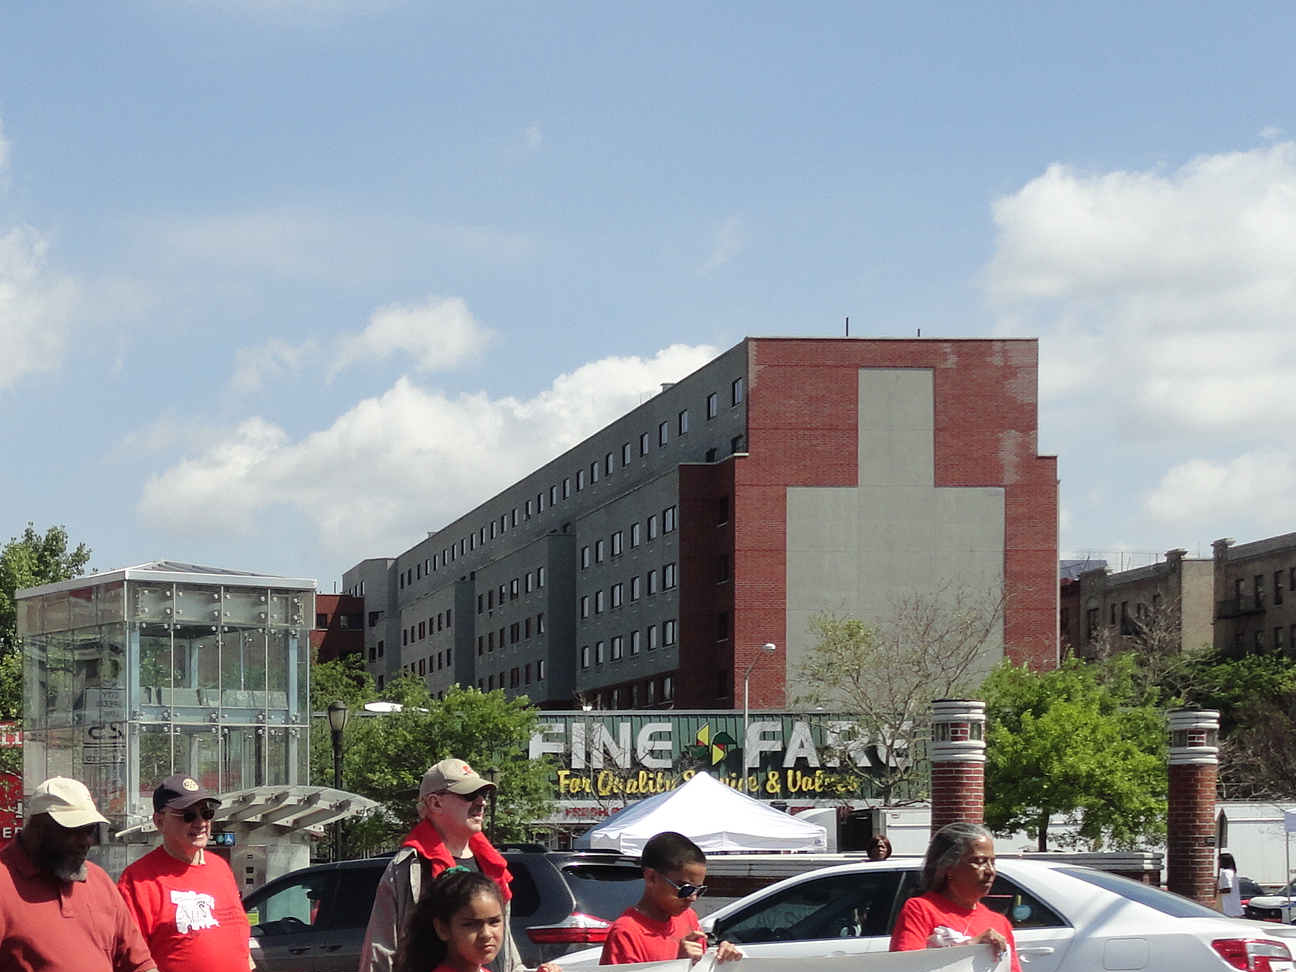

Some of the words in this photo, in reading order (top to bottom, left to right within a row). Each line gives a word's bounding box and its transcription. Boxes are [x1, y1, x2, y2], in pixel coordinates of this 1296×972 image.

[529, 722, 672, 768] FINE
[557, 770, 592, 793] For
[766, 770, 781, 793] &
